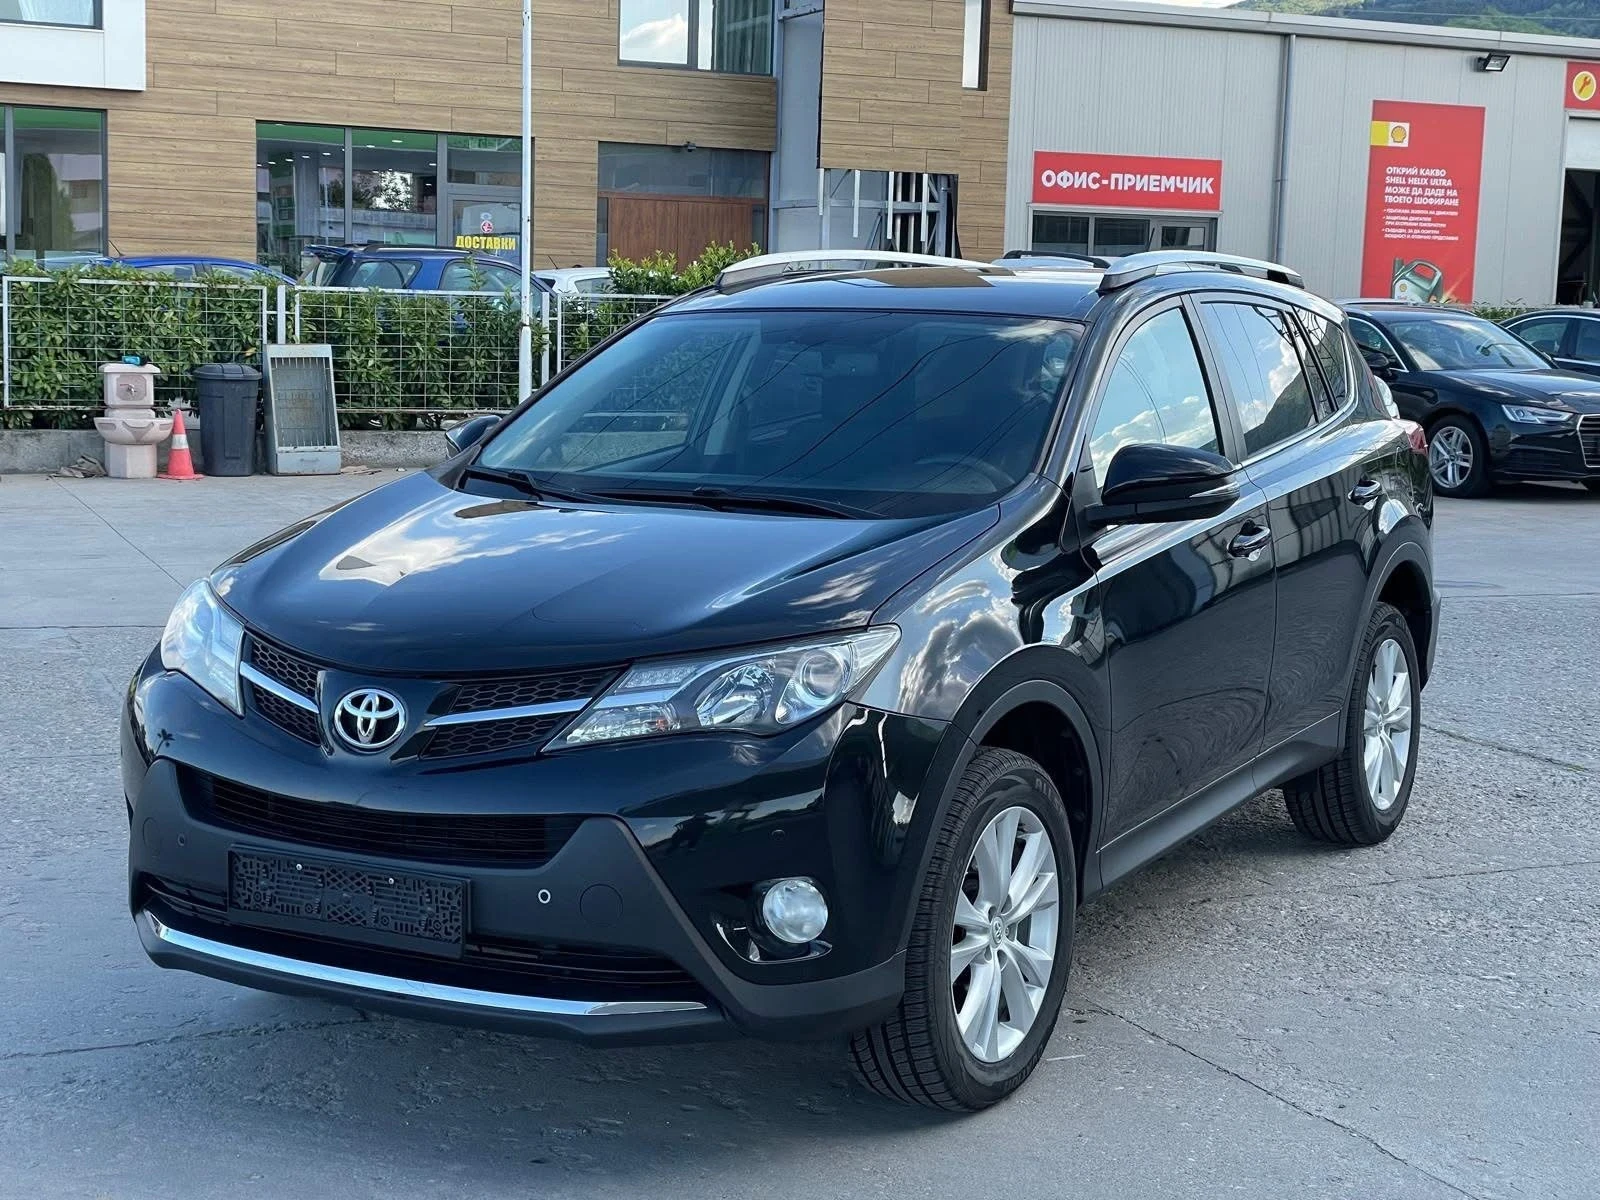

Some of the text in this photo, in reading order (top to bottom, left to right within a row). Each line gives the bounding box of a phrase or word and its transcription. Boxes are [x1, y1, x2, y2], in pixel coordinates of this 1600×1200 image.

[1386, 166, 1447, 177] ОТКРИЙ КАКВО
[1041, 169, 1215, 194] ОФИС-ПРИЕМЧИК
[1385, 176, 1452, 186] SHELL HELIX ULTRA
[1385, 186, 1410, 194] МОЖЕ
[1411, 187, 1423, 195] ДА
[1424, 188, 1445, 196] ДАДЕ
[1384, 195, 1459, 206] ТВОЕТО ШОФИРАНЕ
[455, 236, 516, 250] ДОСТАВКИ
